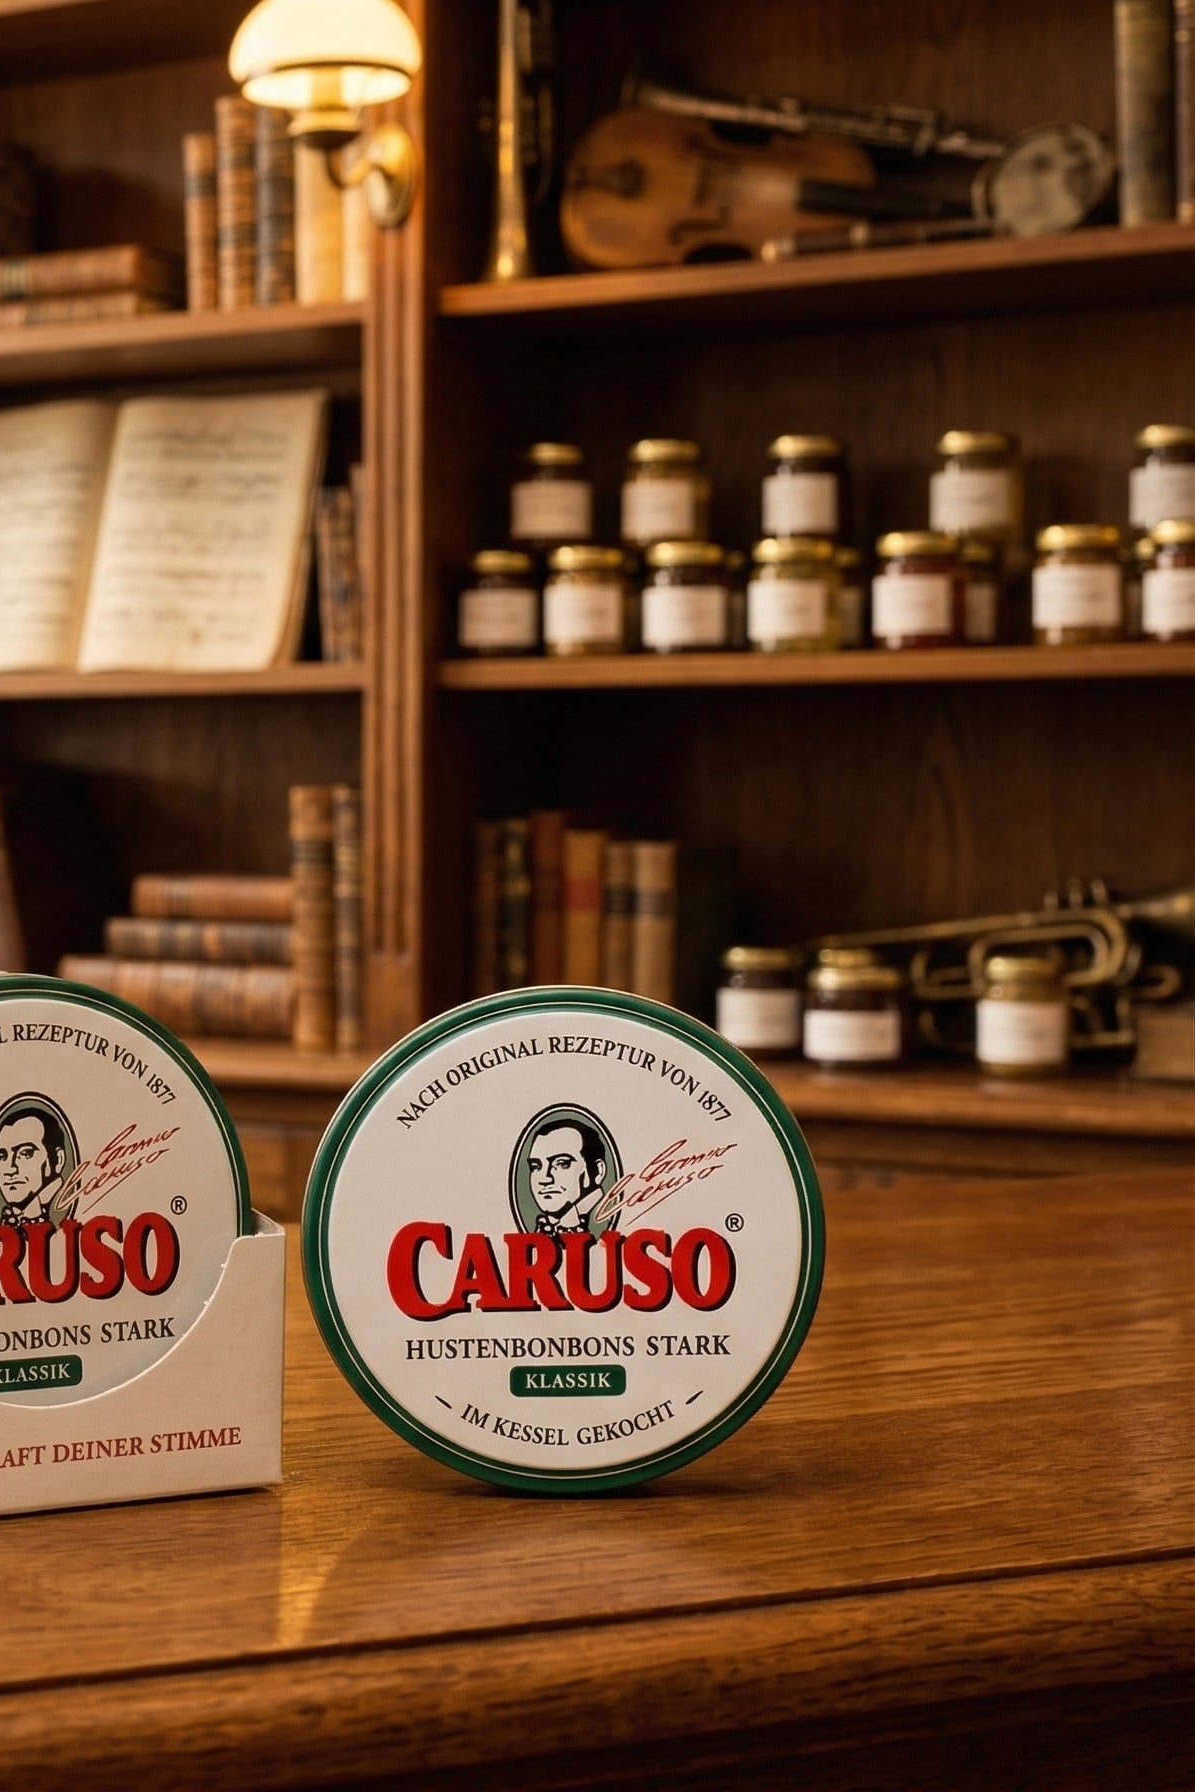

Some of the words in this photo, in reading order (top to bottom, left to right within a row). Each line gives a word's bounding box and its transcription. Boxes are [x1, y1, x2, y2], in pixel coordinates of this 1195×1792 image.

[12, 1023, 109, 1056] REZEPTUR
[112, 1045, 149, 1080] VON
[146, 1072, 176, 1104] 1877
[396, 1080, 447, 1129] NACH
[446, 1039, 543, 1087] ORIGINAL
[548, 1036, 657, 1070] REZEPTUR
[660, 1059, 701, 1097] VON
[697, 1091, 731, 1123] 1877
[387, 1221, 737, 1321] CARUSO
[101, 1317, 175, 1343] STARK
[406, 1335, 635, 1360] HUSTENBONBONS
[646, 1335, 730, 1356] STARK
[525, 1372, 611, 1389] KLASSIK
[460, 1404, 489, 1429] IM
[492, 1416, 569, 1446] KESSEL
[576, 1400, 676, 1445] GEKOCHT
[52, 1436, 143, 1464] DEINER
[150, 1427, 242, 1453] STIMME
